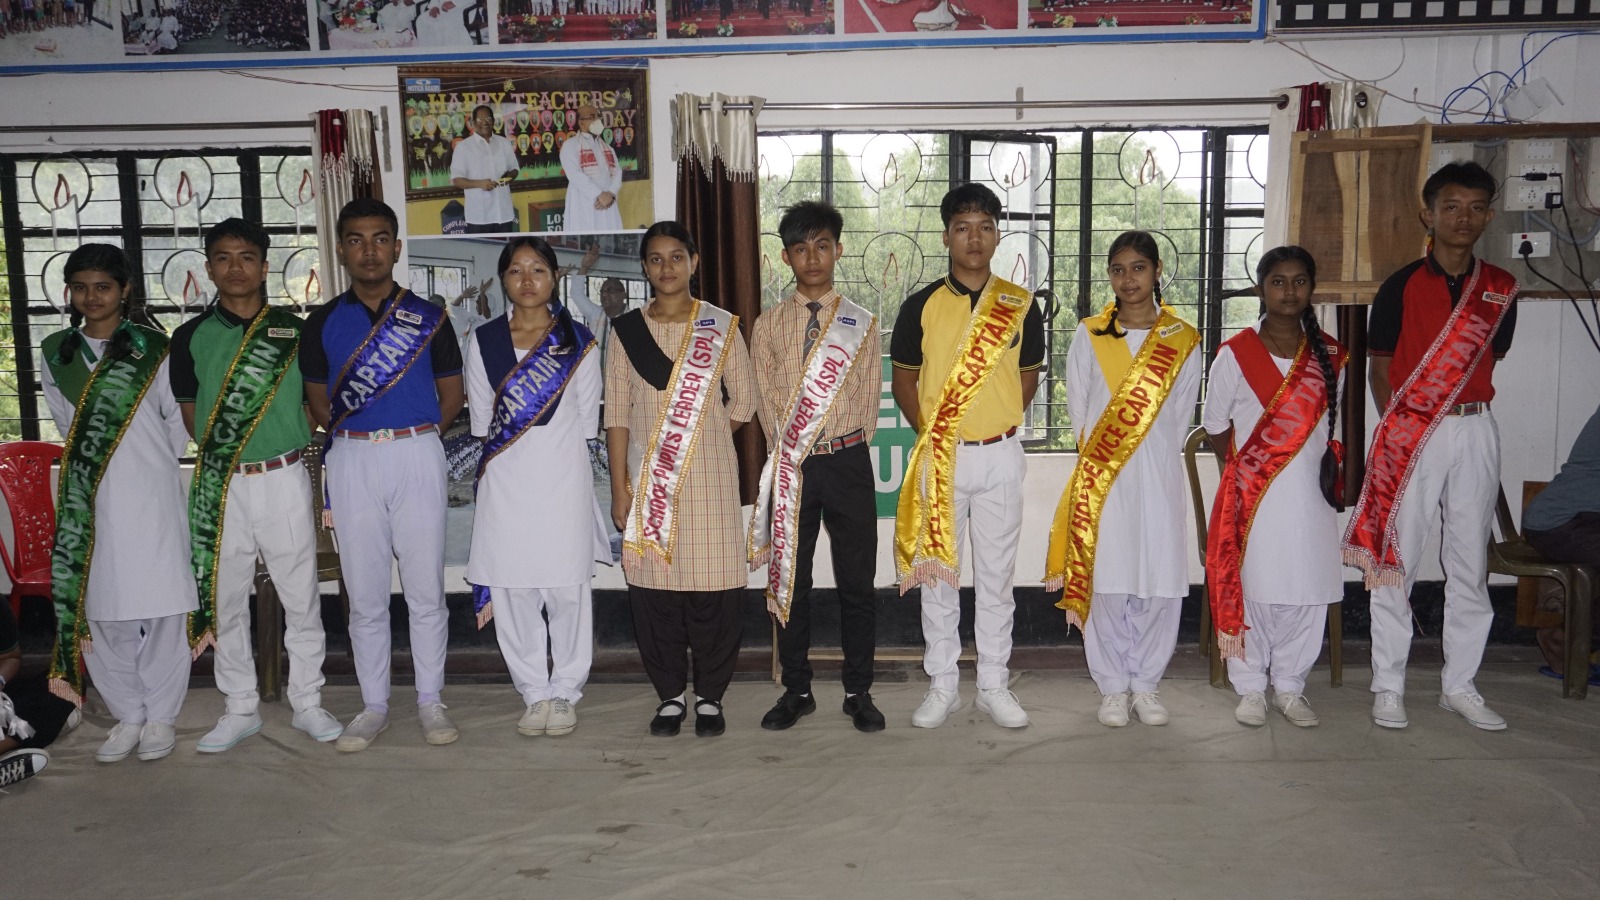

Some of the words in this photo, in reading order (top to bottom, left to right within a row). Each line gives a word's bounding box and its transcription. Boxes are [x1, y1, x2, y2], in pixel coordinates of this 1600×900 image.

[427, 92, 506, 113] HAPPY
[602, 109, 637, 128] DAY
[546, 213, 565, 225] LOS
[341, 320, 421, 411] CAPTAIN
[687, 327, 722, 369] (SPL)
[957, 302, 1016, 388] CAPTAIN
[1406, 314, 1491, 412] CAPTAIN
[80, 359, 137, 457] CAPTAIN
[213, 339, 281, 444] CAPTAIN
[498, 352, 562, 425] CAPTAIN
[673, 371, 705, 429] LEADER
[1089, 422, 1129, 465] VICE
[1117, 343, 1179, 426] CAPTAIN
[782, 396, 821, 451] LEADER
[64, 453, 91, 515] VICE
[1235, 445, 1271, 491] VICE
[643, 481, 667, 541] SCHOOL
[51, 514, 83, 599] HOUSE
